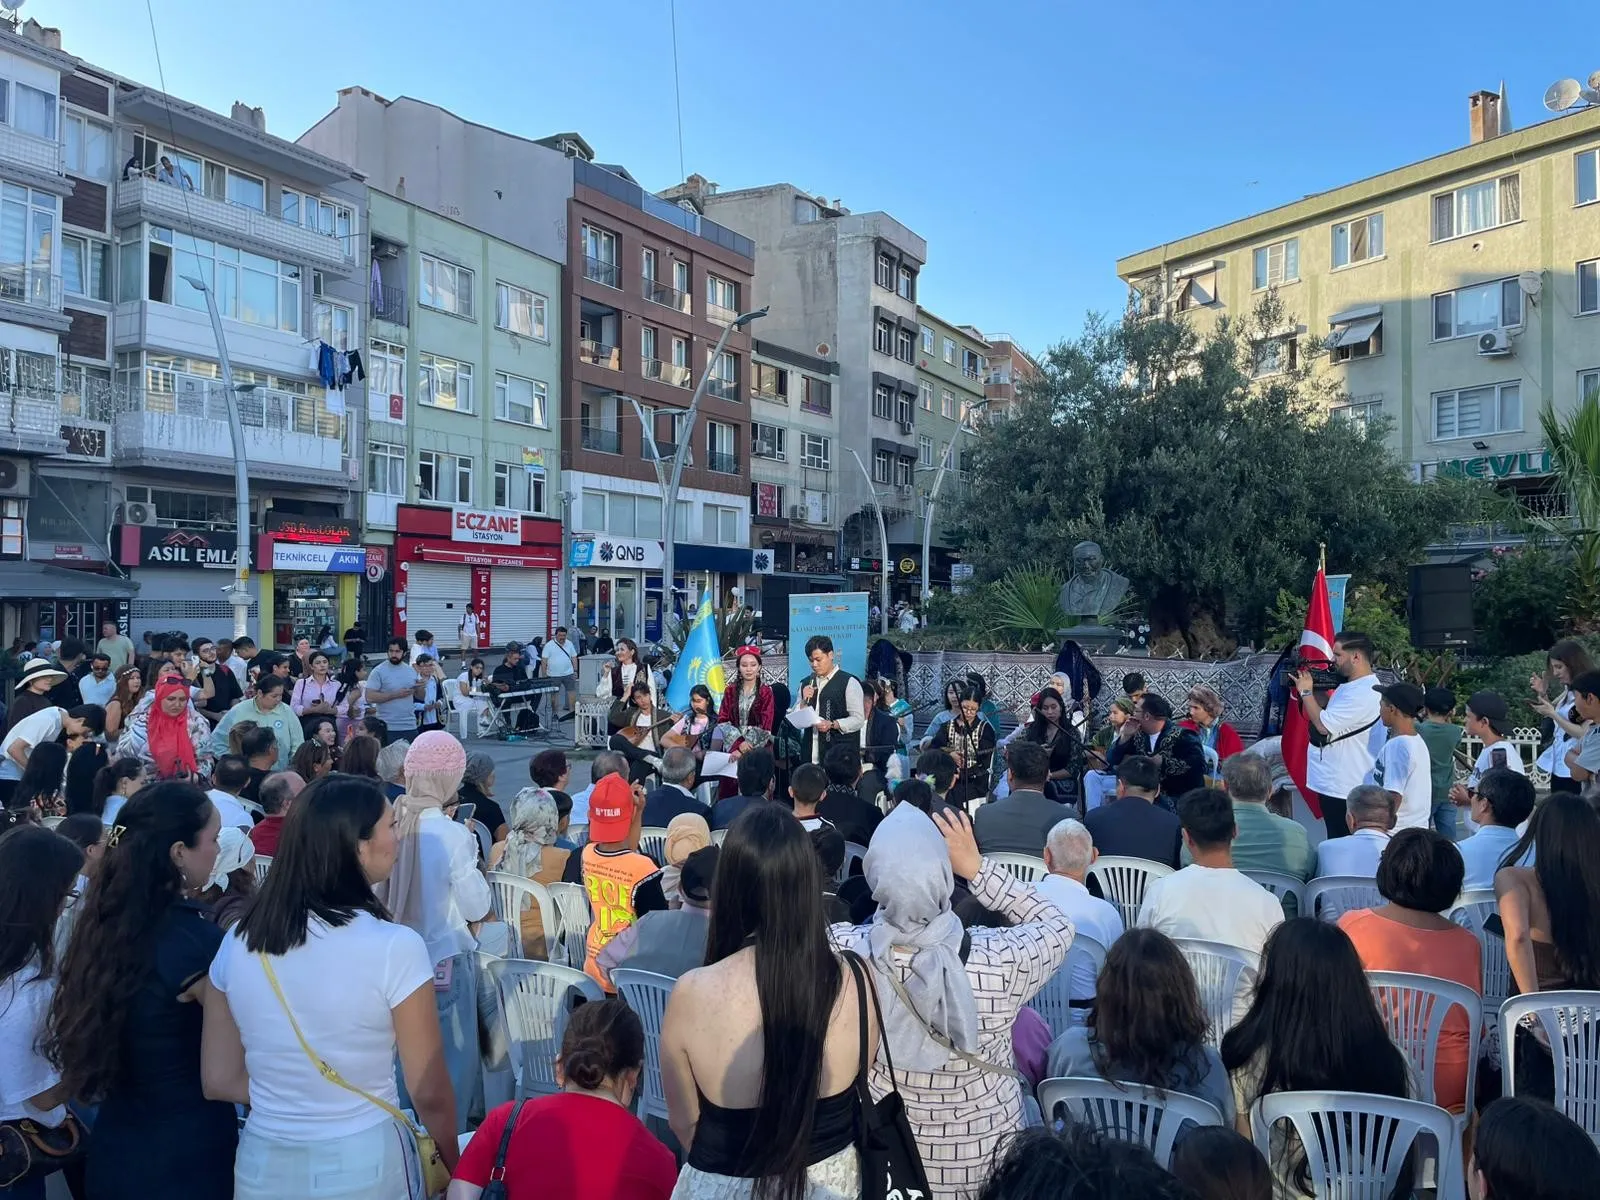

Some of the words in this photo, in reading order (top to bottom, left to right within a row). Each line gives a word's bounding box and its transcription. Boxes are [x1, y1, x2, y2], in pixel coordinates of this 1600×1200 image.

[456, 511, 518, 534] ECZANE
[473, 530, 503, 541] İSTASYON
[148, 543, 190, 562] ASİL
[275, 551, 328, 563] TEKNİKCELL
[338, 554, 359, 565] AKIN
[464, 555, 492, 564] İSTASYON
[616, 545, 645, 562] QNB
[479, 575, 487, 640] ECZANE
